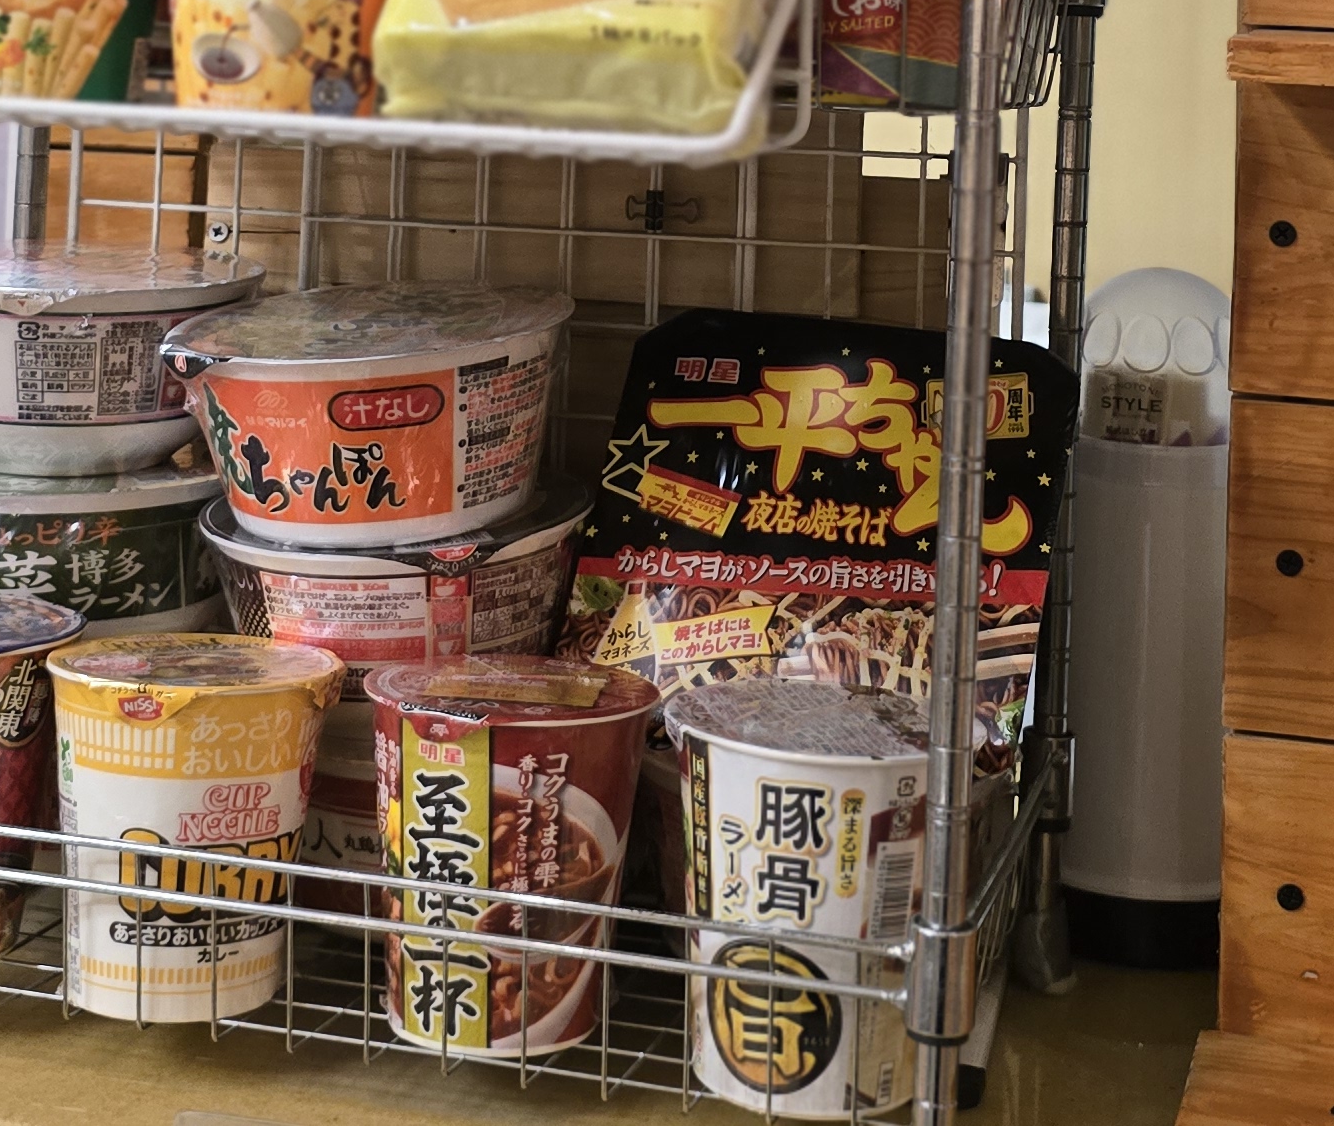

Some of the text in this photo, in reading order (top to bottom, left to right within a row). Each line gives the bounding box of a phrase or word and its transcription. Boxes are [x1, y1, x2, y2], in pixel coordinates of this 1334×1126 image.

[839, 15, 895, 34] SALTED
[675, 357, 741, 385] 明星
[343, 393, 431, 423] 汁なし
[1101, 395, 1164, 413] STYLE
[240, 433, 407, 514] ちゃんぽん
[740, 492, 893, 547] 夜店の焼そば
[64, 547, 146, 586] 博多
[68, 576, 176, 615] ラーメン
[606, 621, 650, 647] からし
[673, 616, 751, 643] 焼そばには
[599, 639, 650, 663] マヨネーズ
[660, 633, 763, 663] このからしマヨ!
[122, 696, 160, 714] NISSI
[190, 709, 293, 744] あっさり
[181, 742, 293, 776] おいしい
[418, 740, 466, 766] 明星
[203, 781, 271, 814] CUP
[534, 752, 570, 887] コクうまの雫
[755, 782, 827, 921] 豚骨
